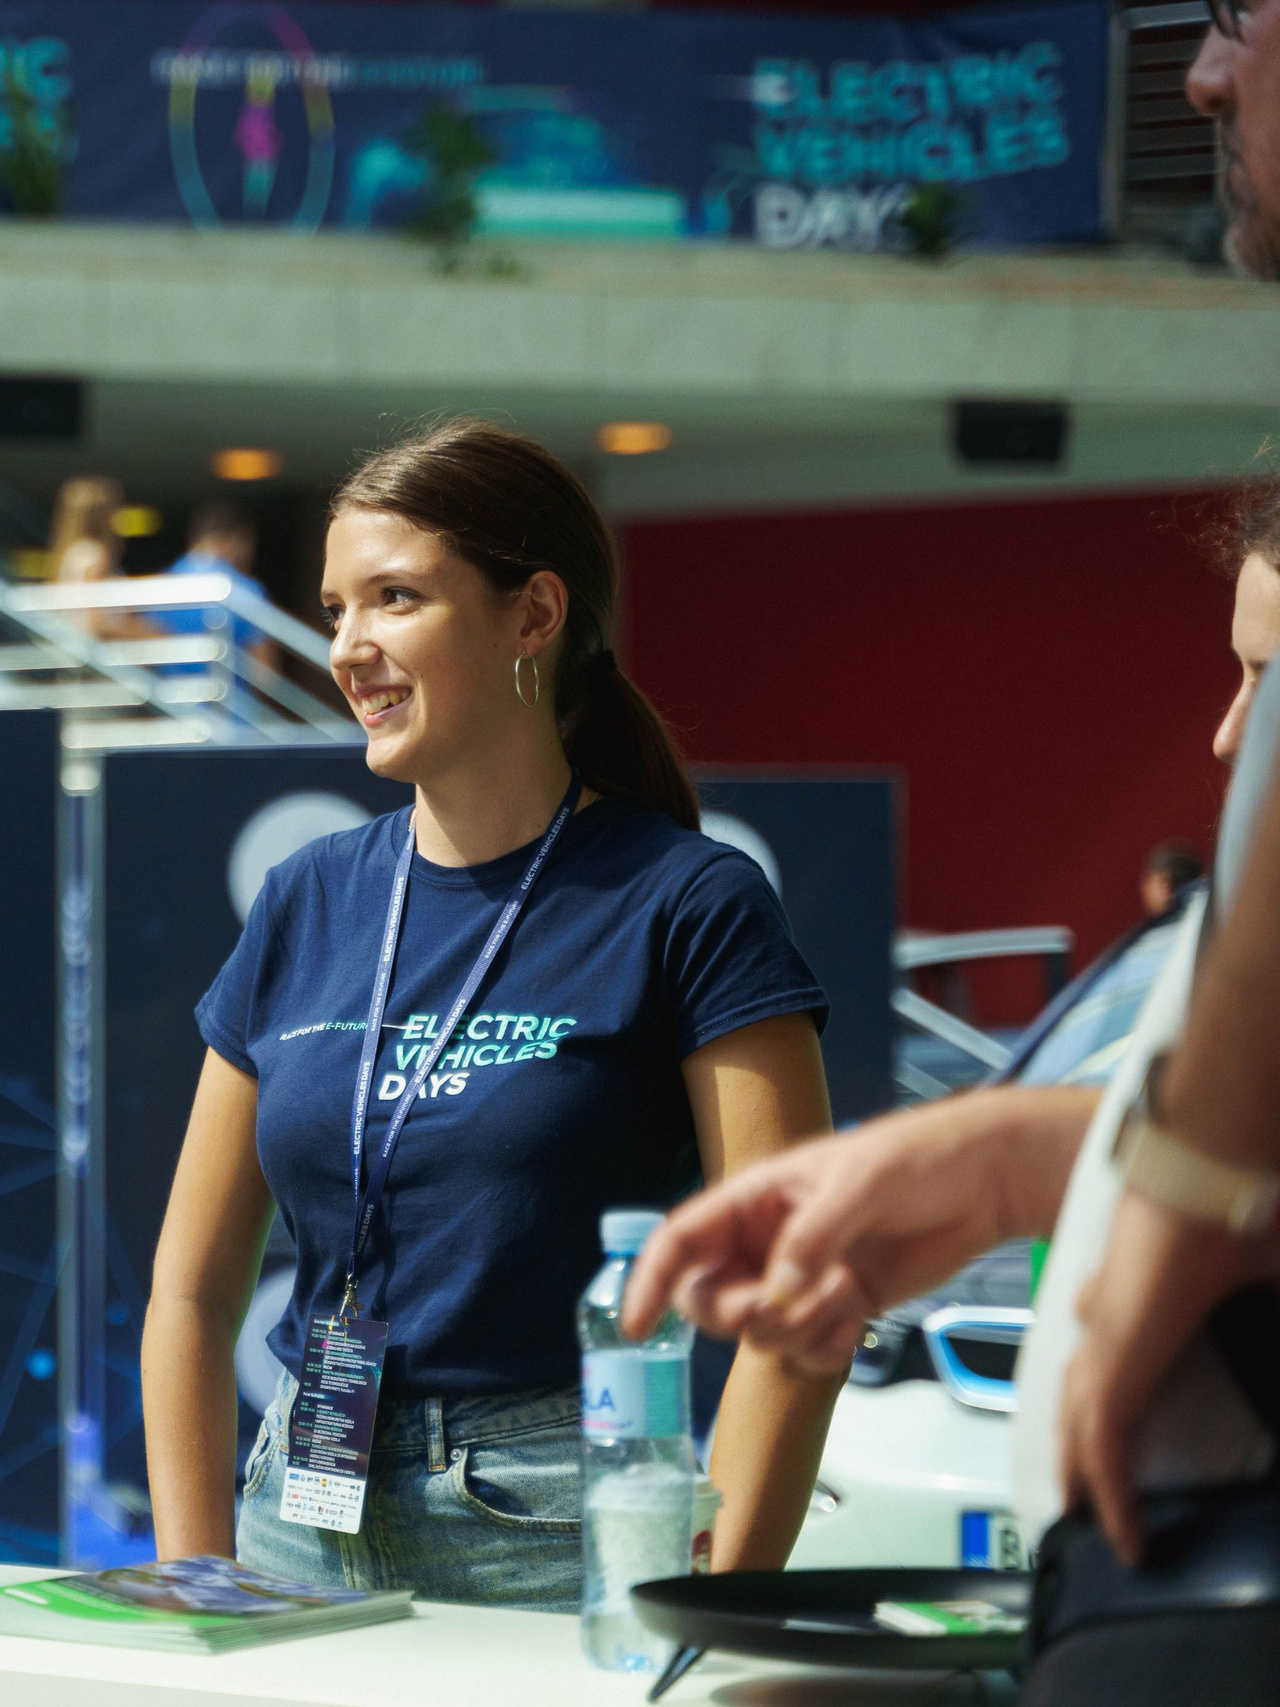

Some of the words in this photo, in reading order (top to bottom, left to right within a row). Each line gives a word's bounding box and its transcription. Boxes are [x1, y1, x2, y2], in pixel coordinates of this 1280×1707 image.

[753, 41, 1062, 120] ELECTRIC
[756, 110, 1068, 184] VEHICLES
[755, 182, 920, 250] DAY
[520, 855, 544, 890] ELECTRIC
[538, 823, 561, 857] VEHICLES
[555, 806, 570, 825] DAYS
[395, 876, 404, 894] DAYS
[389, 894, 402, 928] VEHICLES
[383, 928, 396, 962] ELECTRIC
[492, 933, 500, 945] FOR
[498, 923, 506, 933] THE
[325, 1022, 368, 1031] E-FUTUR
[413, 1049, 437, 1084] ELECTRIC
[432, 1016, 456, 1051] VEHICLES
[451, 997, 466, 1017] DAYS
[360, 1061, 370, 1080] DAYS
[356, 1080, 366, 1116] VEHICLES
[353, 1116, 361, 1155] ELECTRIC
[387, 1130, 395, 1142] FOR
[363, 1202, 374, 1224] DAYS
